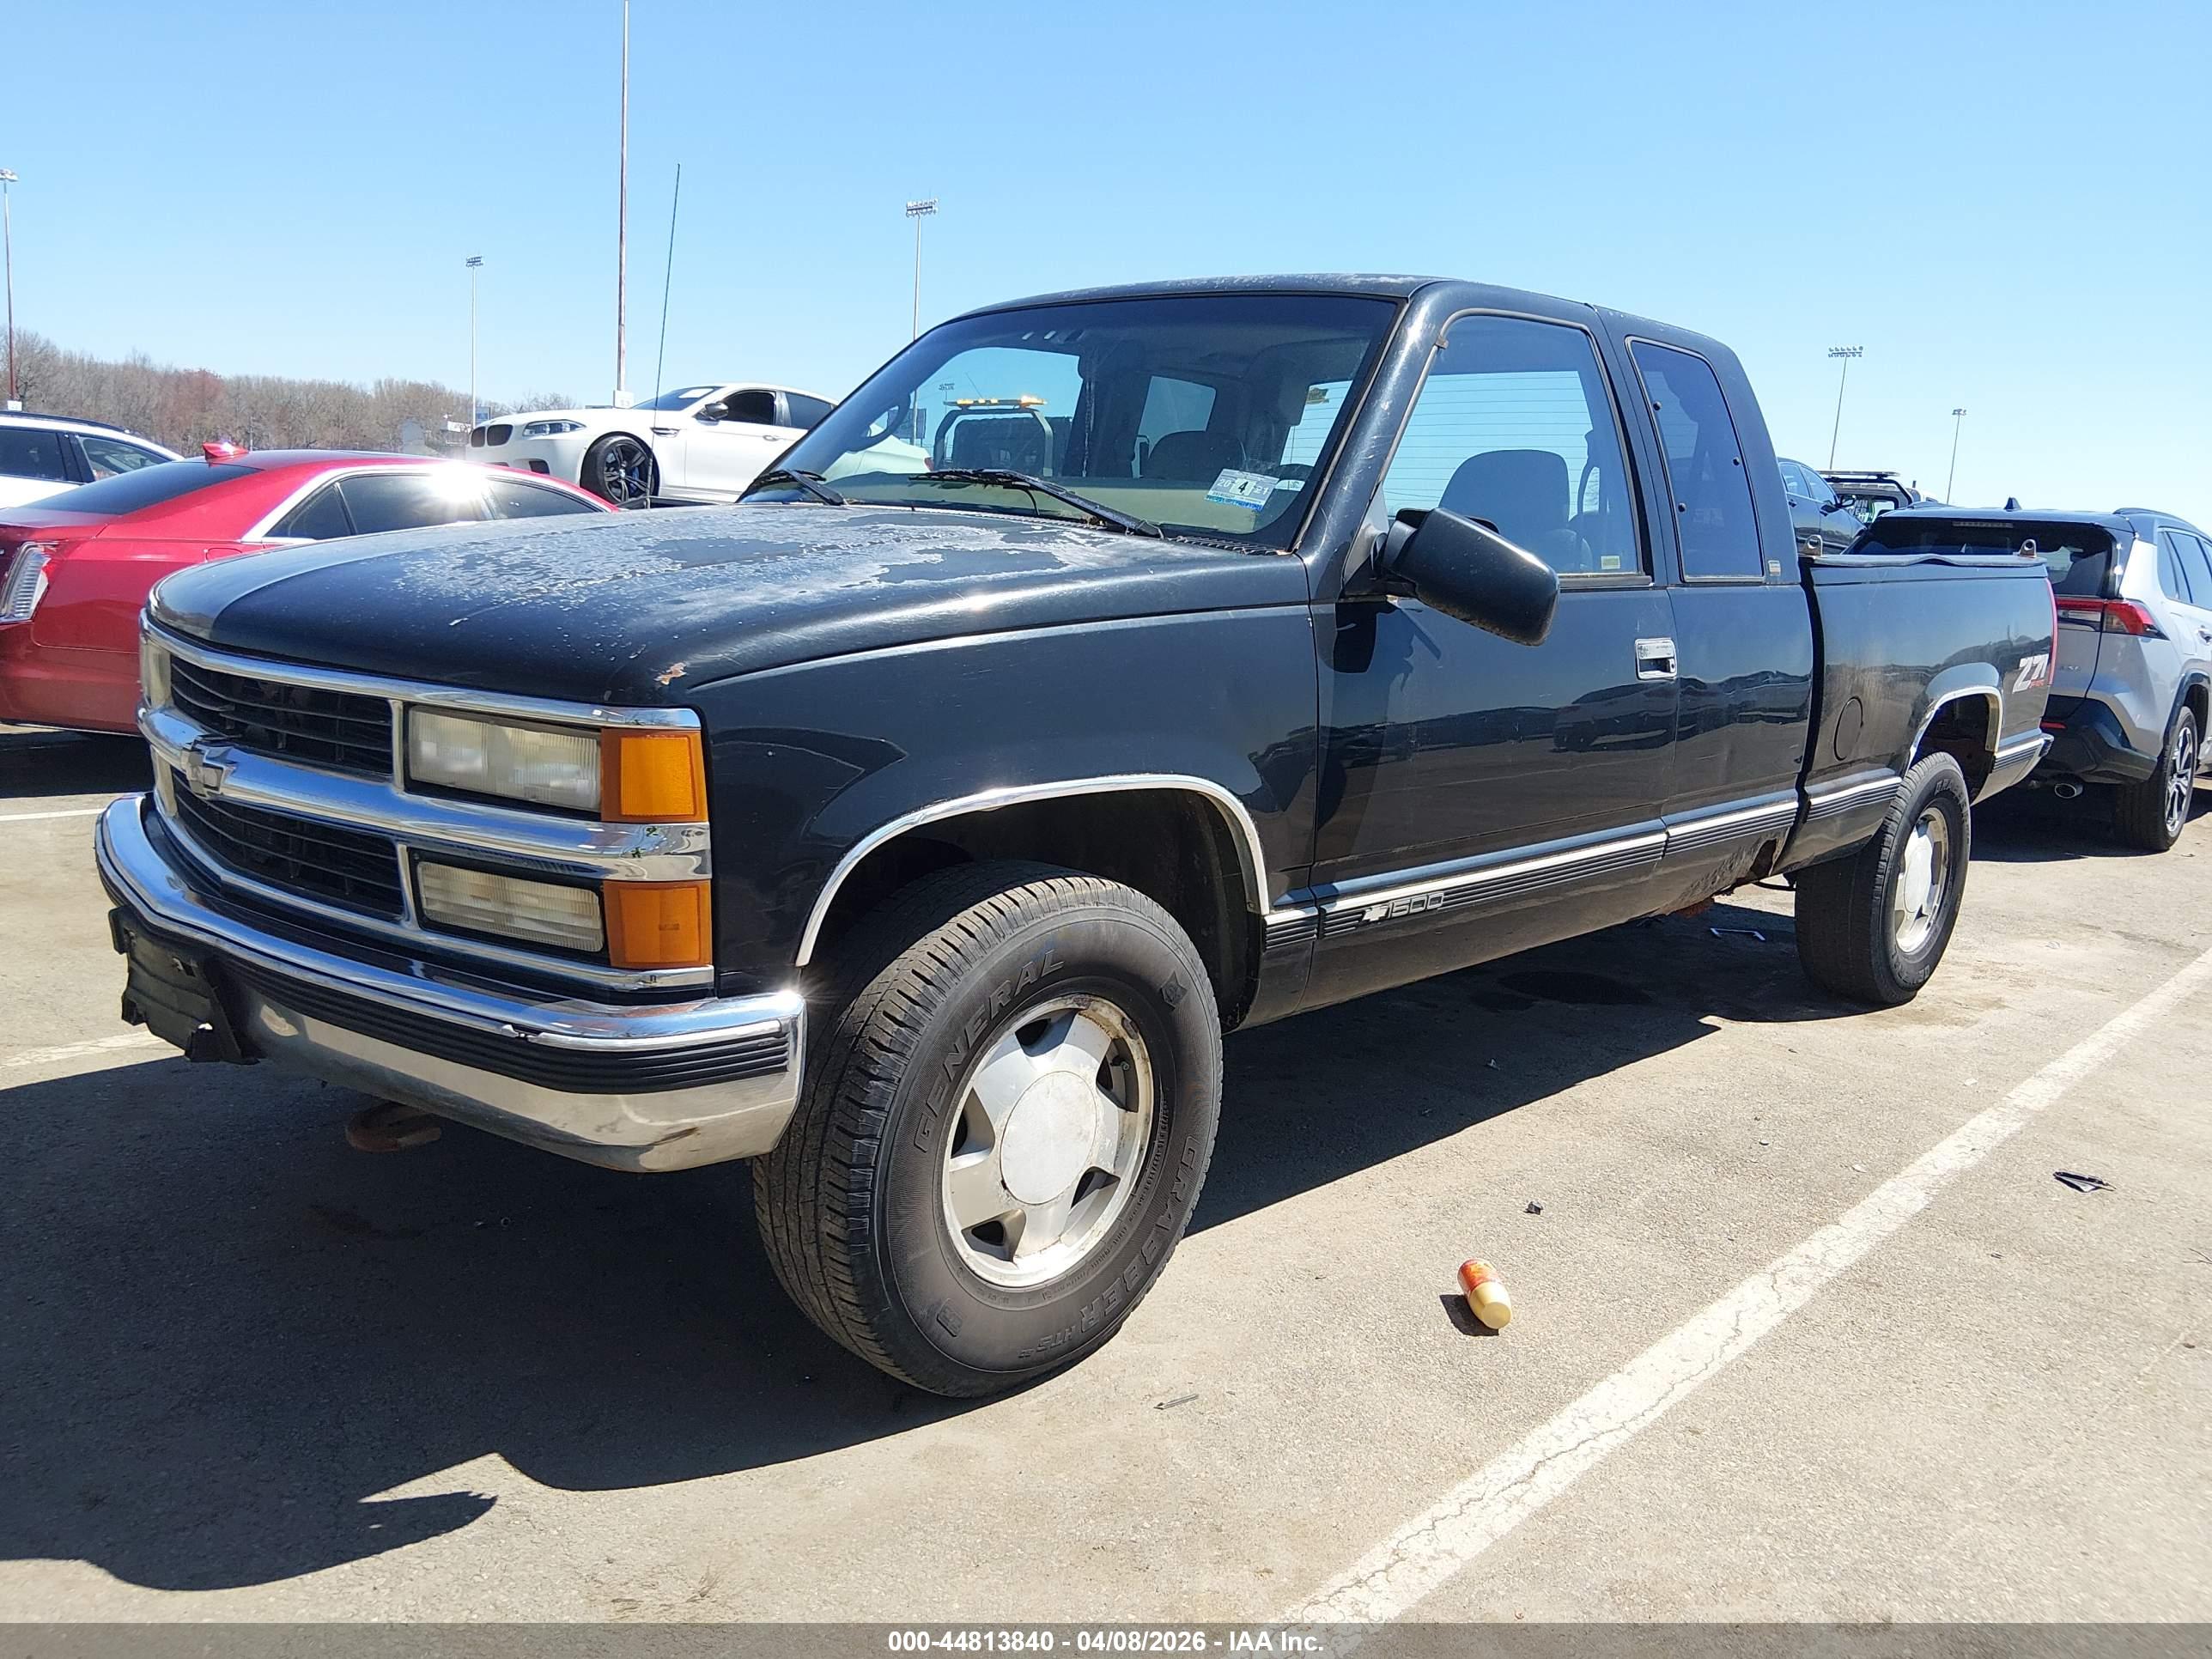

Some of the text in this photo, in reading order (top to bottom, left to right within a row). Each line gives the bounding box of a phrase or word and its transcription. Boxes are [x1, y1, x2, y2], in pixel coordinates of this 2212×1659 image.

[1237, 481, 1249, 494] 4
[2012, 653, 2050, 694] Z71
[1388, 891, 1444, 919] 1500
[914, 949, 1065, 1153] GENERAL
[1079, 1133, 1203, 1334] GRABBER
